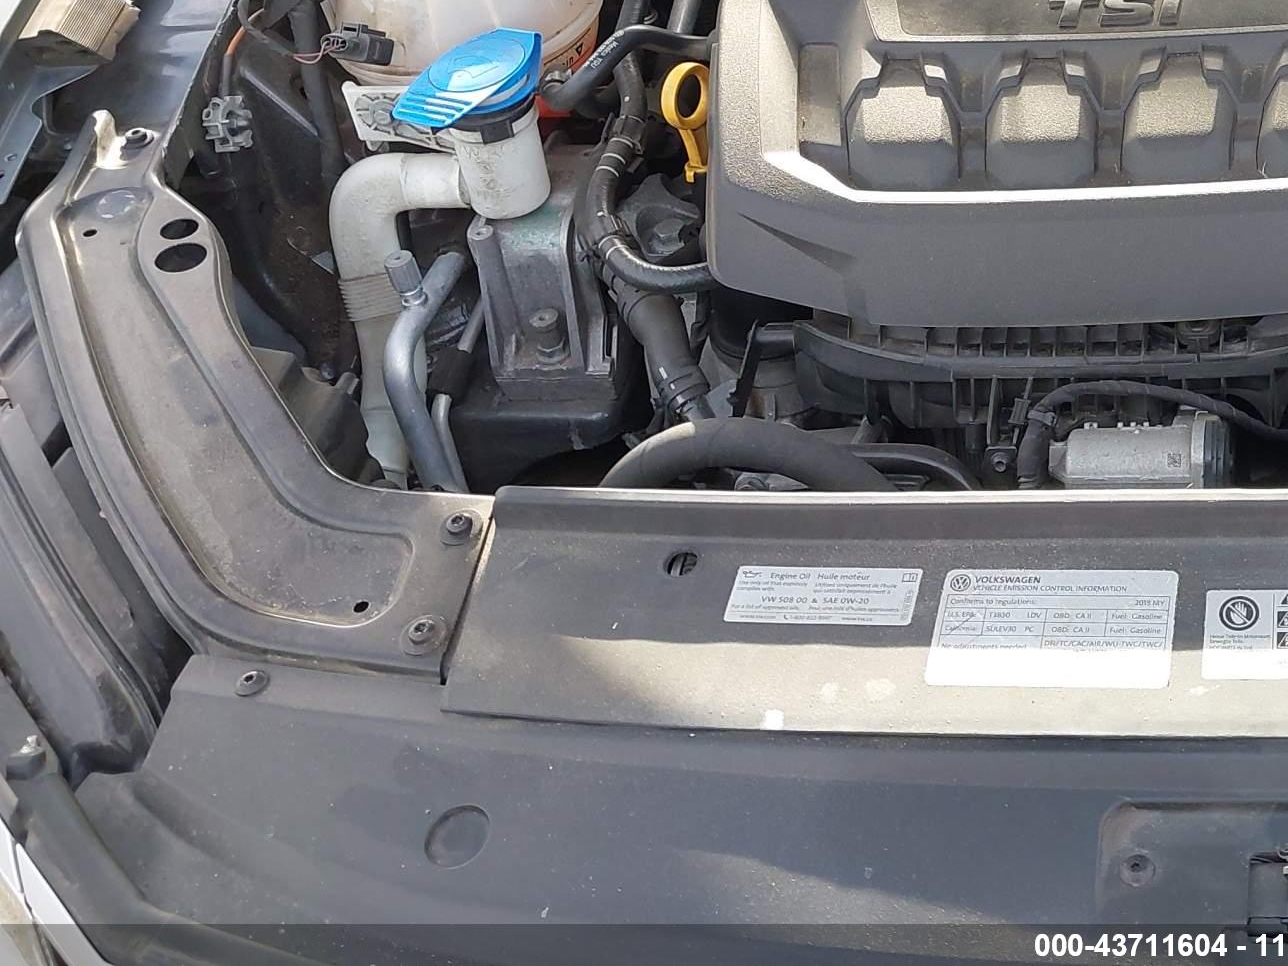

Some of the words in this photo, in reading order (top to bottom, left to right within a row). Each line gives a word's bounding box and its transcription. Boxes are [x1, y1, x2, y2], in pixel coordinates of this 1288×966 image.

[770, 572, 797, 581] Engine
[817, 573, 839, 581] Huile
[840, 573, 871, 581] moteur
[975, 576, 1041, 584] VOLKSWAGEN
